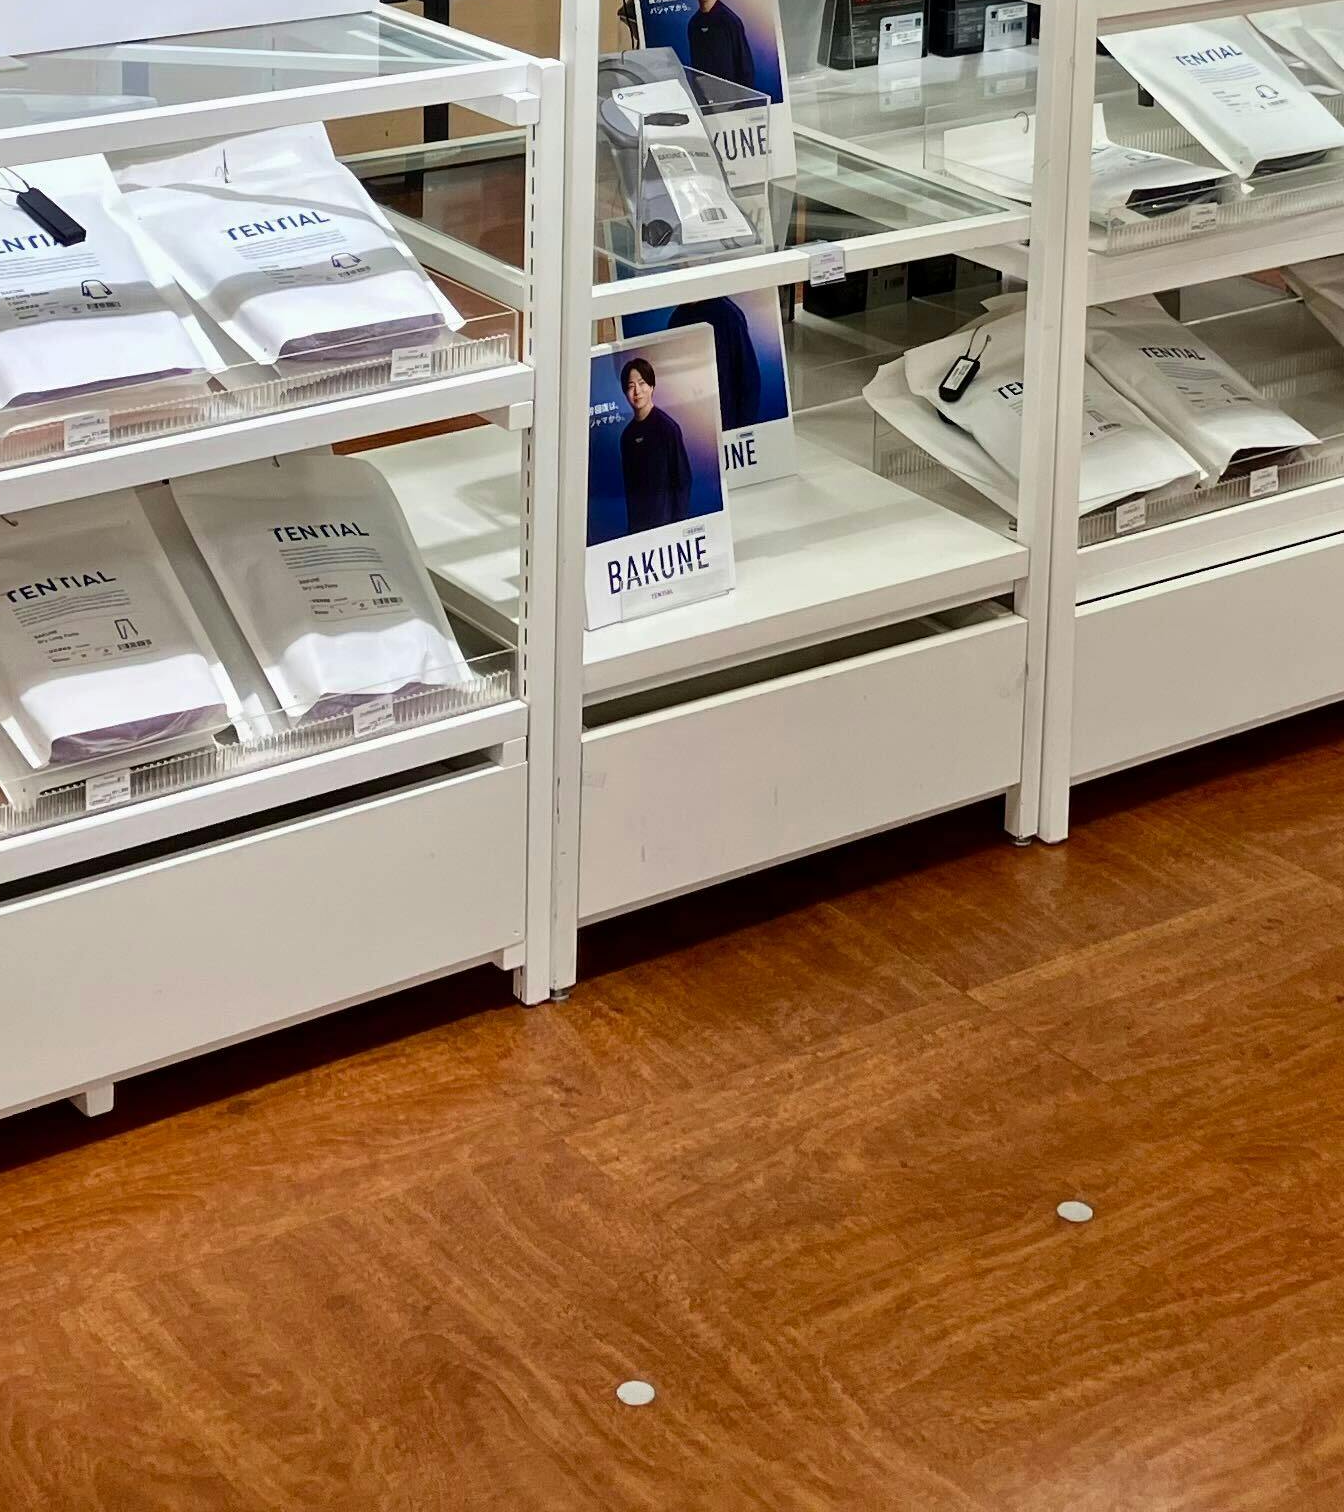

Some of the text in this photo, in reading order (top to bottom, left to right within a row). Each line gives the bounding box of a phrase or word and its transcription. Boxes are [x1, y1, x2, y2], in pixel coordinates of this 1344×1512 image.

[223, 210, 331, 242] TENTIAL
[1139, 346, 1207, 362] TENTIAL
[590, 412, 627, 429] ジャマから。
[268, 521, 370, 543] TENTIAL
[607, 535, 710, 595] BAKUNE
[1, 570, 117, 604] TENTIAL
